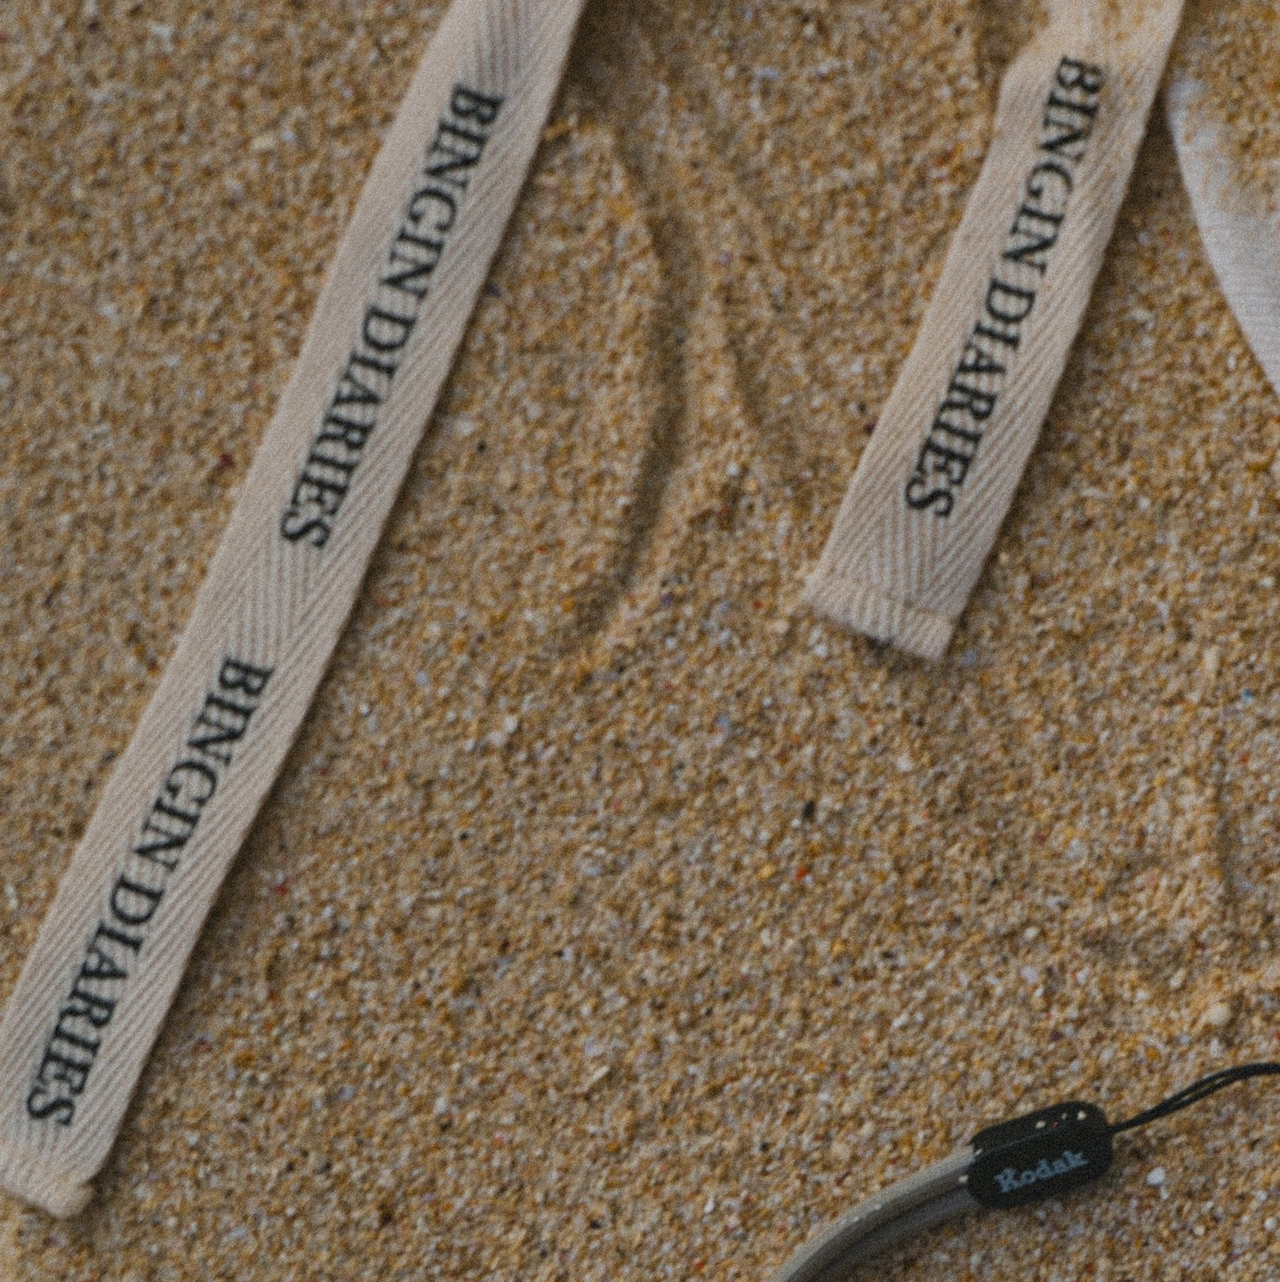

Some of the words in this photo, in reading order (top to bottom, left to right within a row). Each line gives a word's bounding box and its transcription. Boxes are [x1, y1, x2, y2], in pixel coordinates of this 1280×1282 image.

[379, 82, 504, 303] BINGIN
[1001, 55, 1108, 277] BINGIN
[280, 302, 418, 549] DIARIES
[905, 276, 1037, 519] DIARIES
[133, 656, 276, 875] BINGIN
[26, 871, 166, 1128] DIARIES
[994, 1150, 1089, 1194] Kodak
